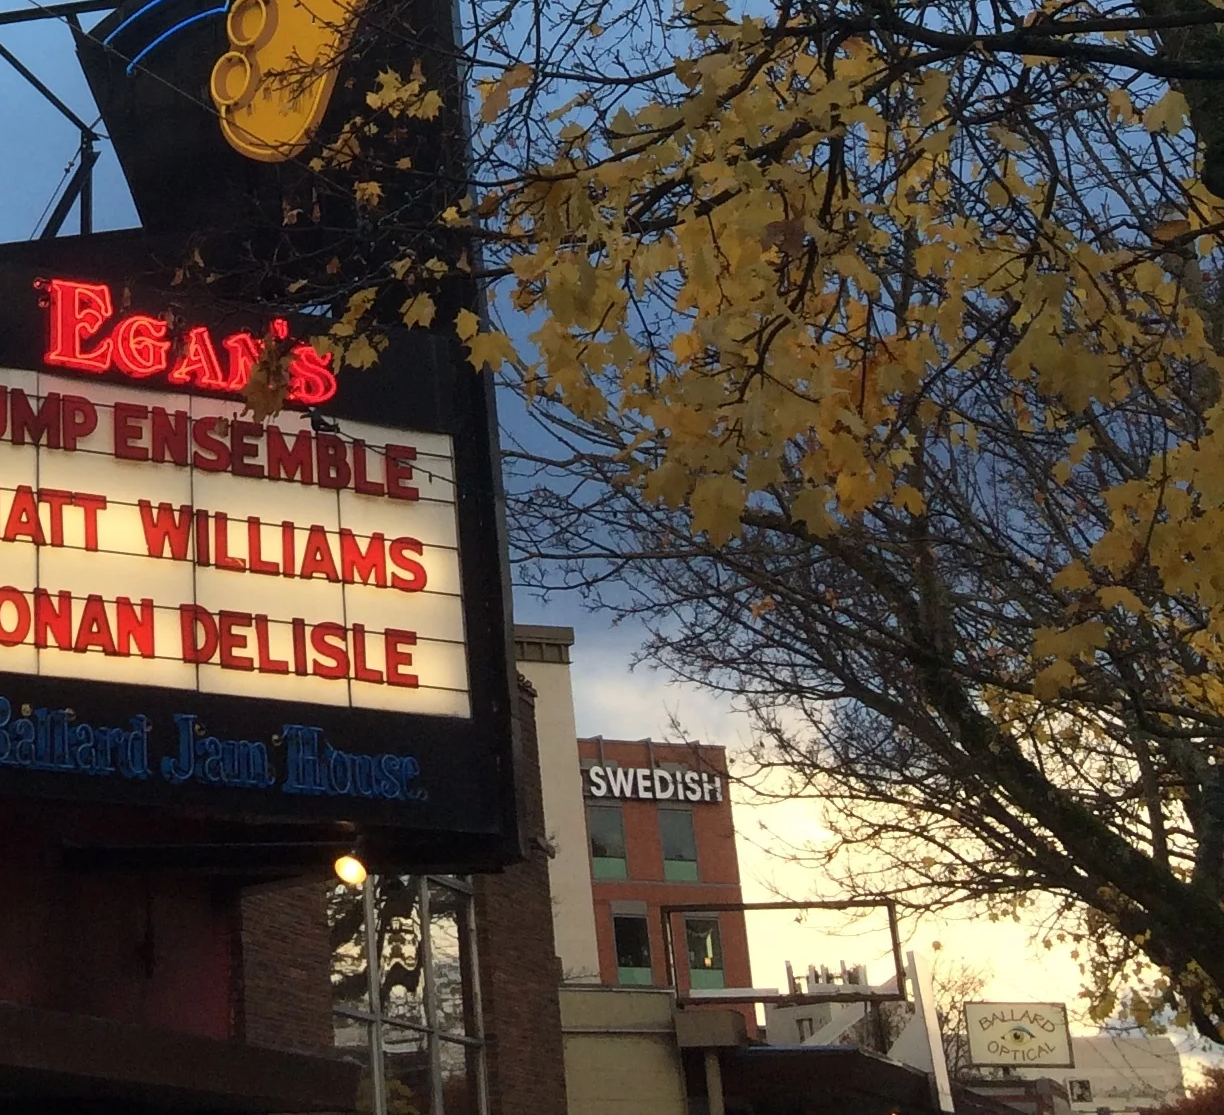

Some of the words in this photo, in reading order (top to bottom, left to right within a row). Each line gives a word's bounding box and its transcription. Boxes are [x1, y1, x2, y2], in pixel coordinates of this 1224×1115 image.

[113, 402, 420, 502] ENSEMBLE
[138, 499, 428, 593] WILLIAMS
[179, 603, 420, 689] DELISLE
[160, 713, 275, 786] Jam
[280, 724, 421, 800] House
[589, 765, 723, 802] SWEDISH
[978, 1009, 1055, 1033] BALLARD
[987, 1040, 1056, 1062] OPTICAL
